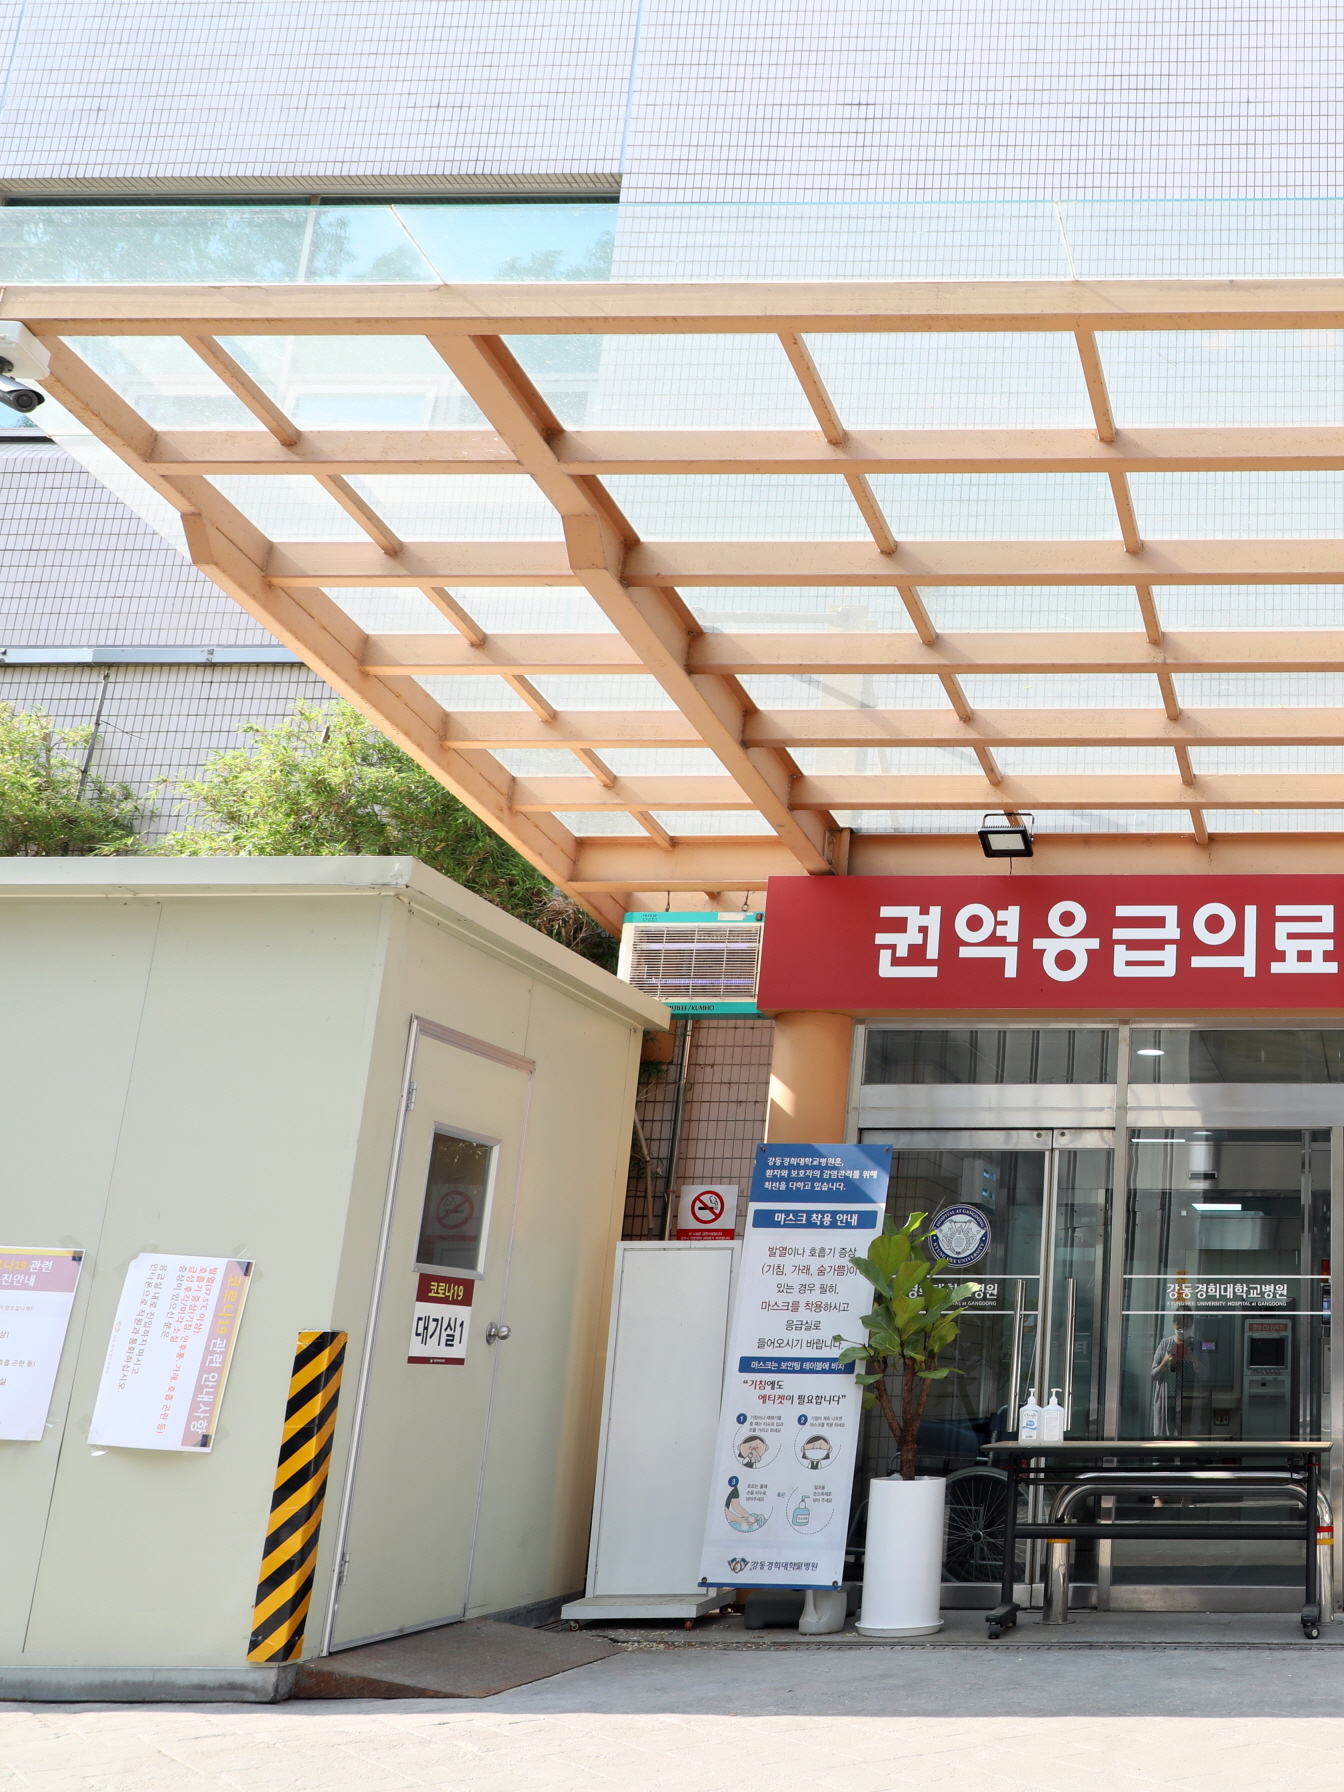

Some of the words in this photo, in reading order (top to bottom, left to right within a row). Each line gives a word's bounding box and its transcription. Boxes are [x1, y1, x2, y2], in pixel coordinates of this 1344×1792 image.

[767, 1157, 845, 1167] 강동경희대학교병원은,
[765, 1169, 788, 1178] 환자와
[790, 1169, 821, 1178] 보호자의
[822, 1170, 860, 1179] 감염관리를
[862, 1170, 878, 1179] 위해
[764, 1182, 787, 1190] 최선을
[789, 1182, 811, 1190] 다하고
[813, 1182, 846, 1191] 있습니다.
[774, 1213, 807, 1225] 마스크
[810, 1213, 832, 1226] 착용
[836, 1213, 858, 1226] 안내
[768, 1246, 806, 1258] 발열이나
[808, 1247, 836, 1258] 호흡기
[838, 1247, 857, 1259] 증상
[29, 1260, 53, 1273] 관련
[185, 1266, 197, 1282] 급성
[761, 1263, 788, 1277] (기침,
[790, 1264, 813, 1277] 가래,
[140, 1264, 159, 1306] 인터폰으로
[153, 1265, 168, 1289] 응급실
[173, 1266, 187, 1291] 증상이
[193, 1267, 207, 1292] 호흡기
[428, 1281, 464, 1301] 코로나19
[776, 1283, 795, 1295] 있는
[797, 1283, 816, 1295] 경우
[819, 1283, 839, 1296] 필히,
[1166, 1283, 1288, 1299] 강동경희대학교병원
[149, 1292, 160, 1308] 내로
[166, 1293, 180, 1319] 있으신
[216, 1274, 243, 1335] 코로나19
[761, 1300, 800, 1313] 마스크를
[803, 1300, 850, 1313] 착용하시고
[131, 1309, 145, 1335] 직원과
[138, 1312, 154, 1346] 진입하지
[160, 1322, 172, 1338] 분은
[785, 1320, 822, 1331] 응급실로
[169, 1326, 181, 1343] 소실
[414, 1315, 465, 1348] 대기실1
[756, 1337, 803, 1350] 들어오시기
[805, 1338, 844, 1350] 바랍니다.
[206, 1338, 227, 1368] 관련
[131, 1349, 144, 1375] 마시고
[751, 1361, 779, 1370] 마스크는
[780, 1361, 801, 1371] 보안팀
[802, 1361, 829, 1371] 테이블에
[190, 1373, 218, 1435] 안내사항
[757, 1394, 795, 1405] 에티켓이
[751, 1560, 819, 1572] 강동경희대학교병원
